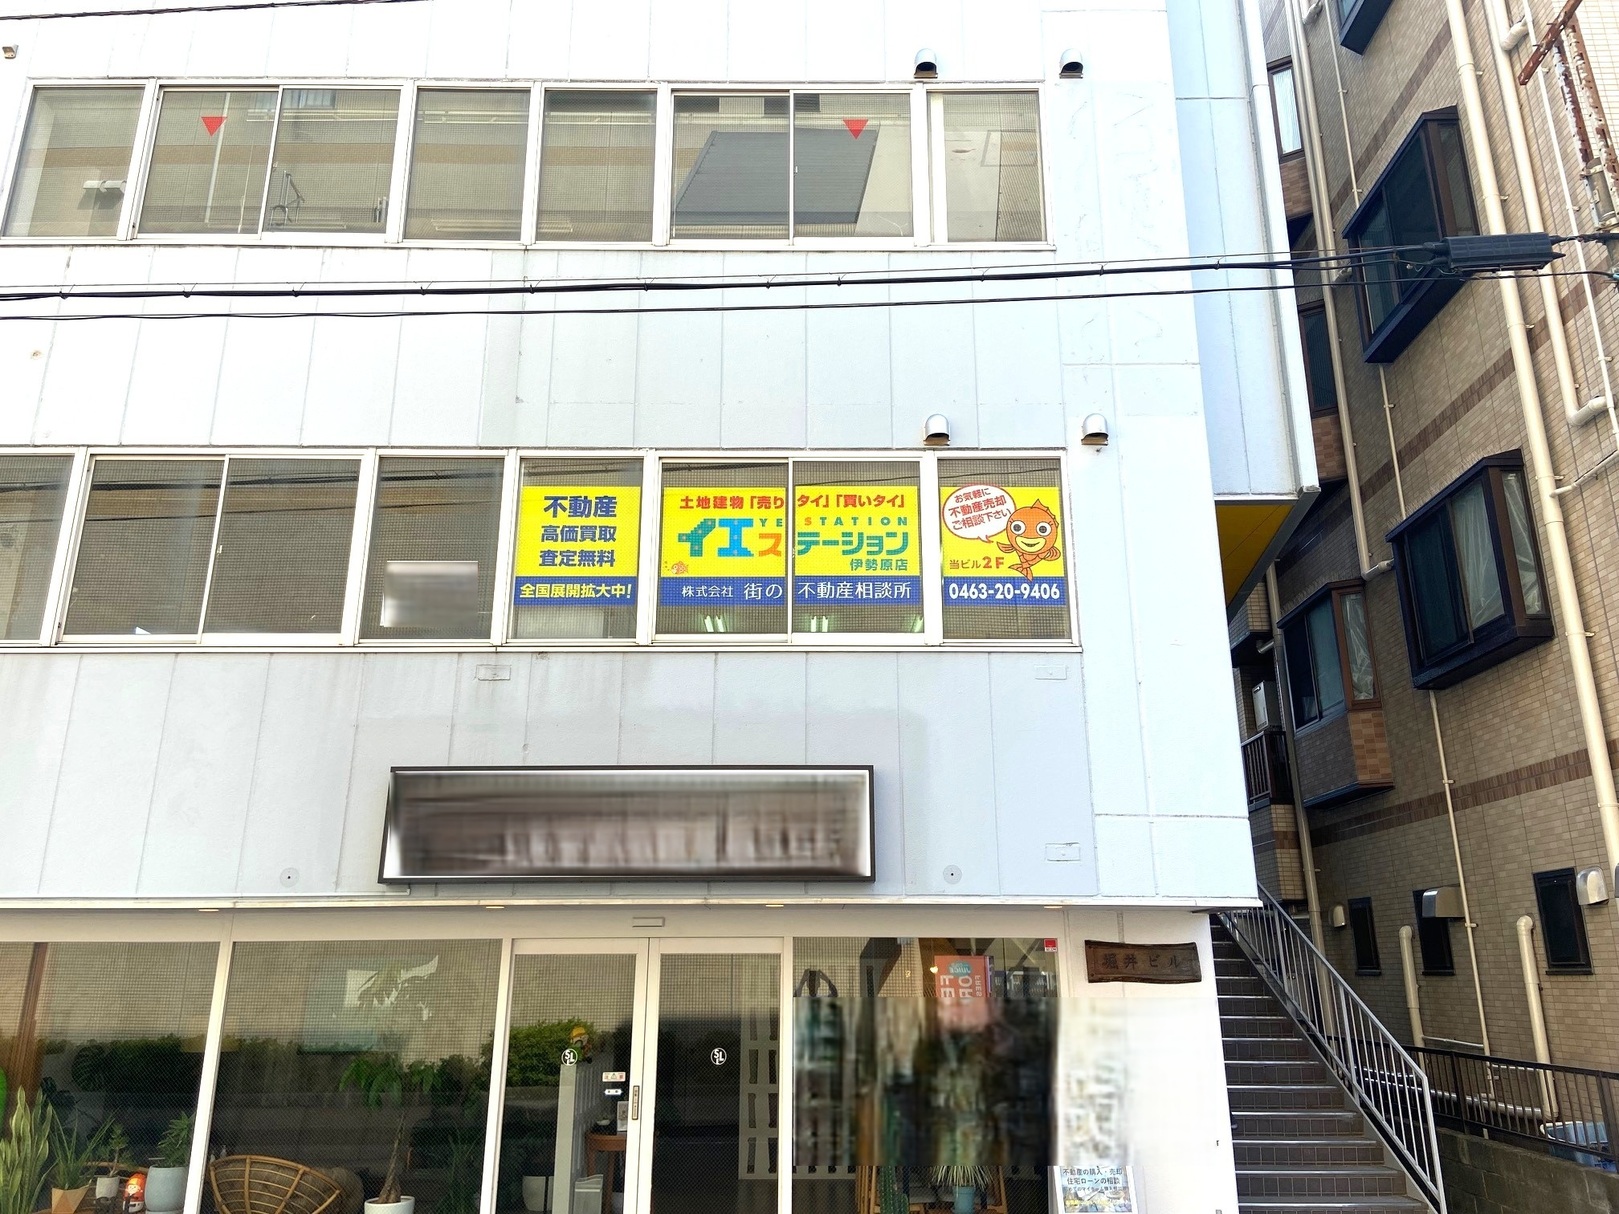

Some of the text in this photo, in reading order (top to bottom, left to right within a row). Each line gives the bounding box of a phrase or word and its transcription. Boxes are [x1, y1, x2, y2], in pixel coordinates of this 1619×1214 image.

[954, 488, 991, 503] お気軽に
[544, 496, 617, 518] 不動産
[948, 494, 1007, 518] 不動産売却
[952, 508, 1012, 530] ご相談下さい
[541, 525, 617, 542] 高価買取
[539, 550, 615, 567] 査定無料
[850, 558, 908, 571] 伊勢原店
[682, 585, 734, 598] 株式会社
[948, 583, 1060, 599] 0463-20-9406
